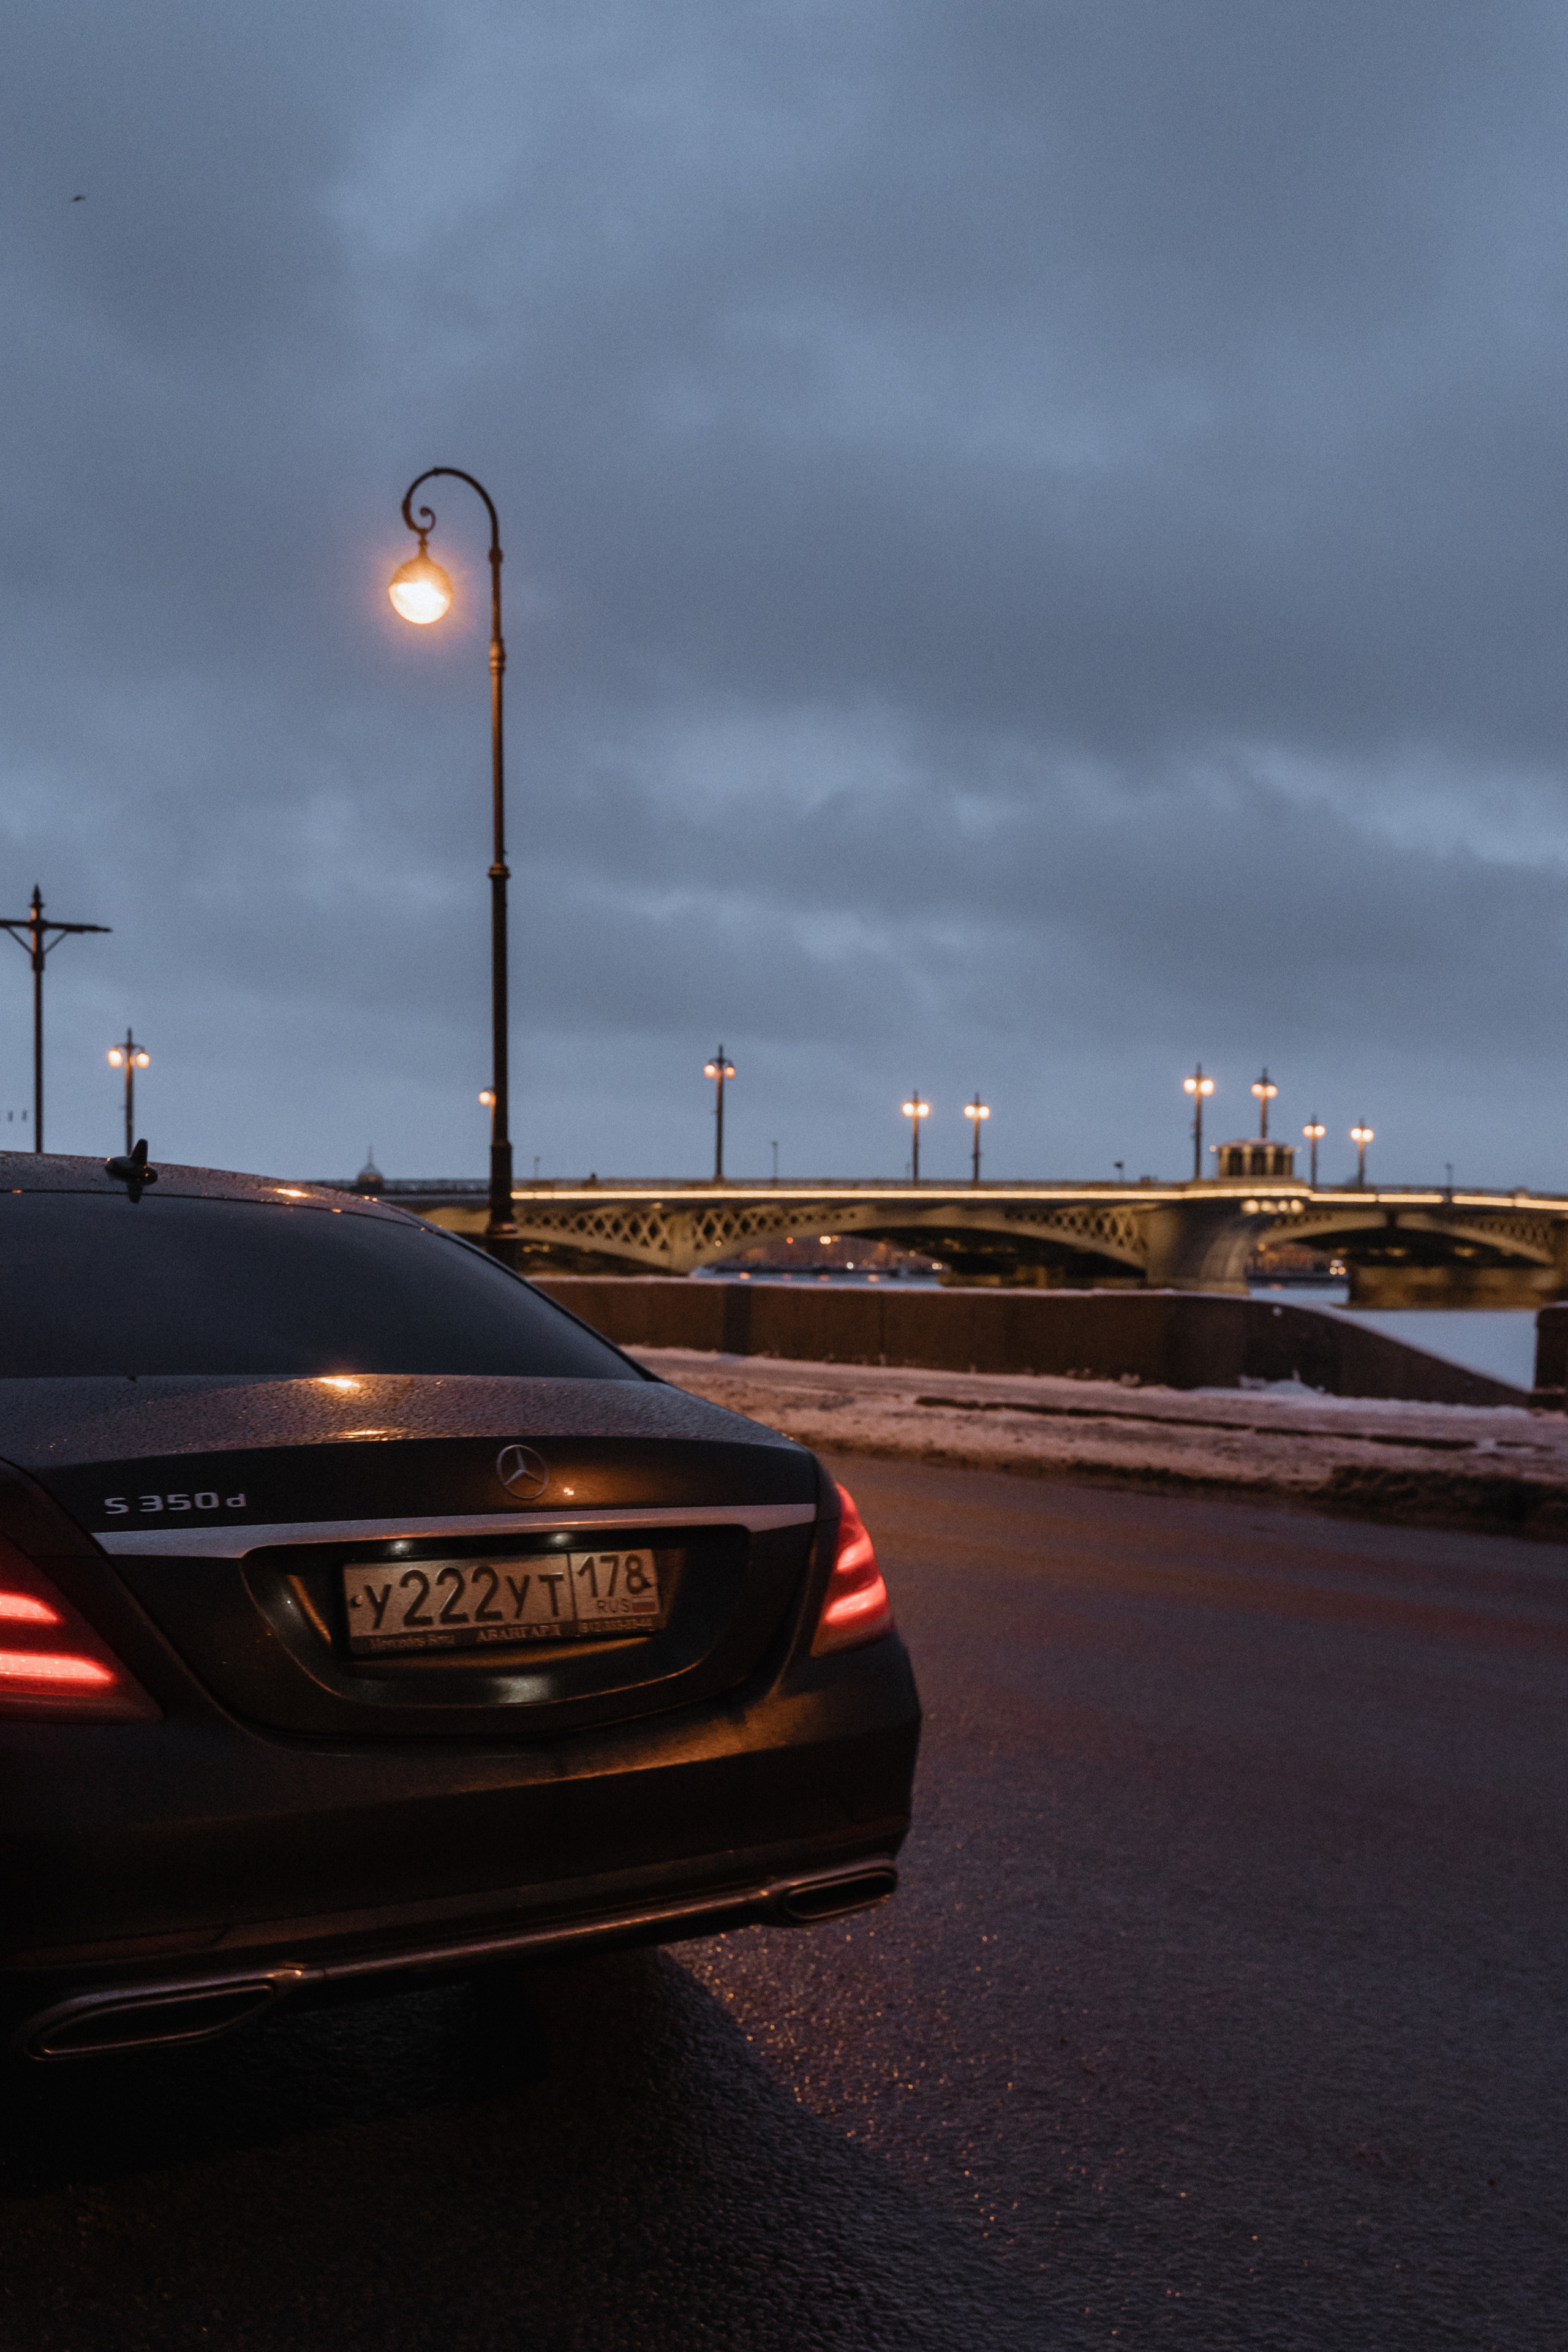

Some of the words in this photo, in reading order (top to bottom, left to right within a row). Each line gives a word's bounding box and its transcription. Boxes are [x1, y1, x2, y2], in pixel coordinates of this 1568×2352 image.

[104, 1497, 130, 1515] S
[576, 1554, 645, 1598] 178
[596, 1597, 631, 1614] RUS
